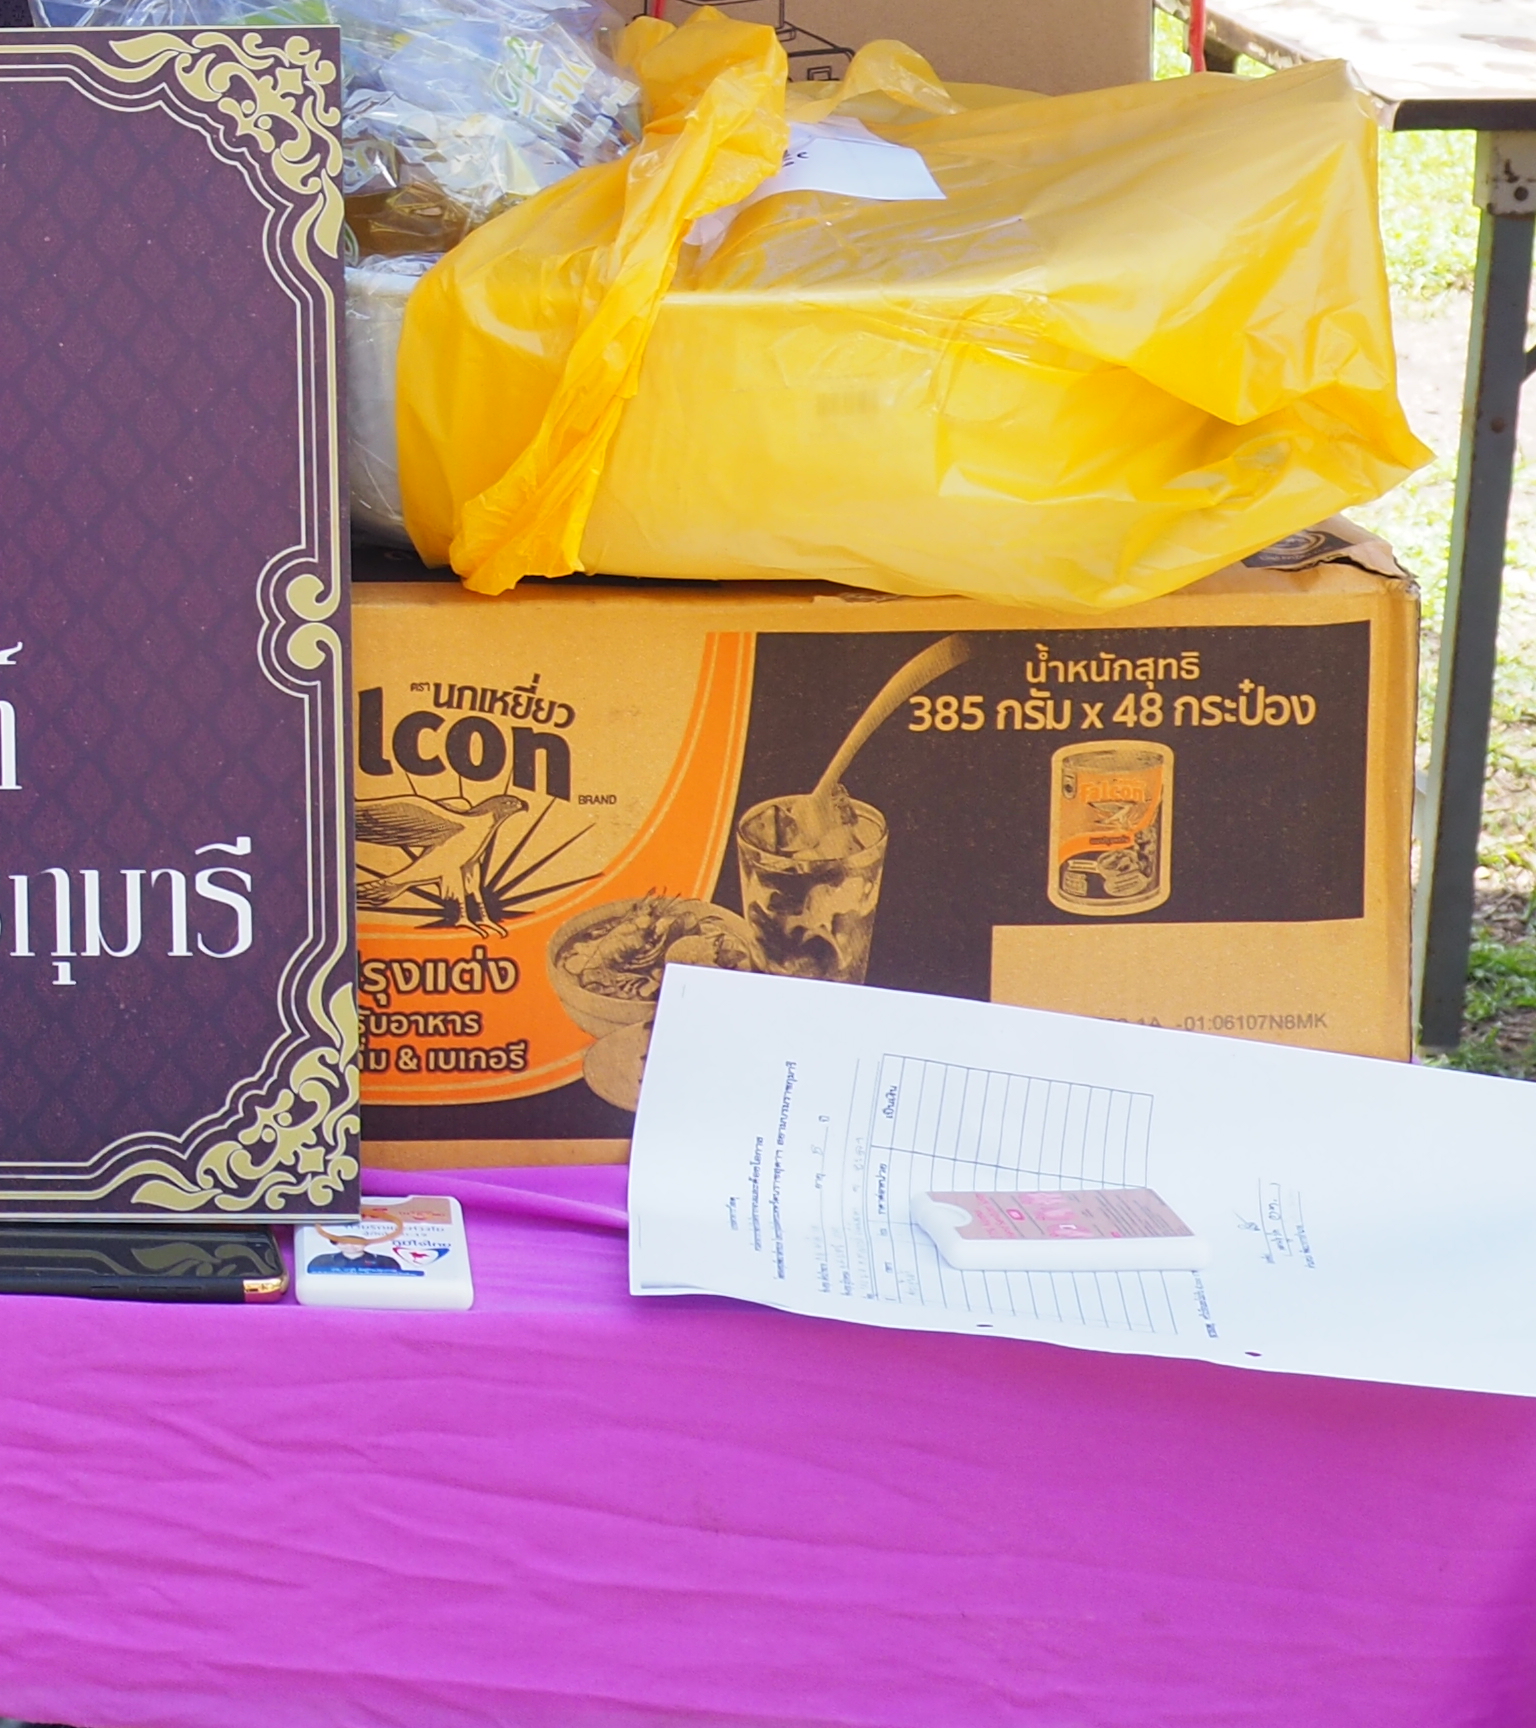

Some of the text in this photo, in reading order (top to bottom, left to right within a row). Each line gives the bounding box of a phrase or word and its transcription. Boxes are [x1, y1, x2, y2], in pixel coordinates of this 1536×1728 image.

[1025, 642, 1202, 689] น้ำหนักสุทธิ
[432, 672, 577, 729] นกเหยี่ยว
[907, 677, 1317, 732] 385 กรัม x 48 กระป๋อง
[357, 686, 572, 803] lcon
[578, 794, 618, 806] BRAND
[358, 944, 520, 1008] รุงแต่ง
[398, 1048, 419, 1071] &
[428, 1040, 527, 1071] เบเกอรี
